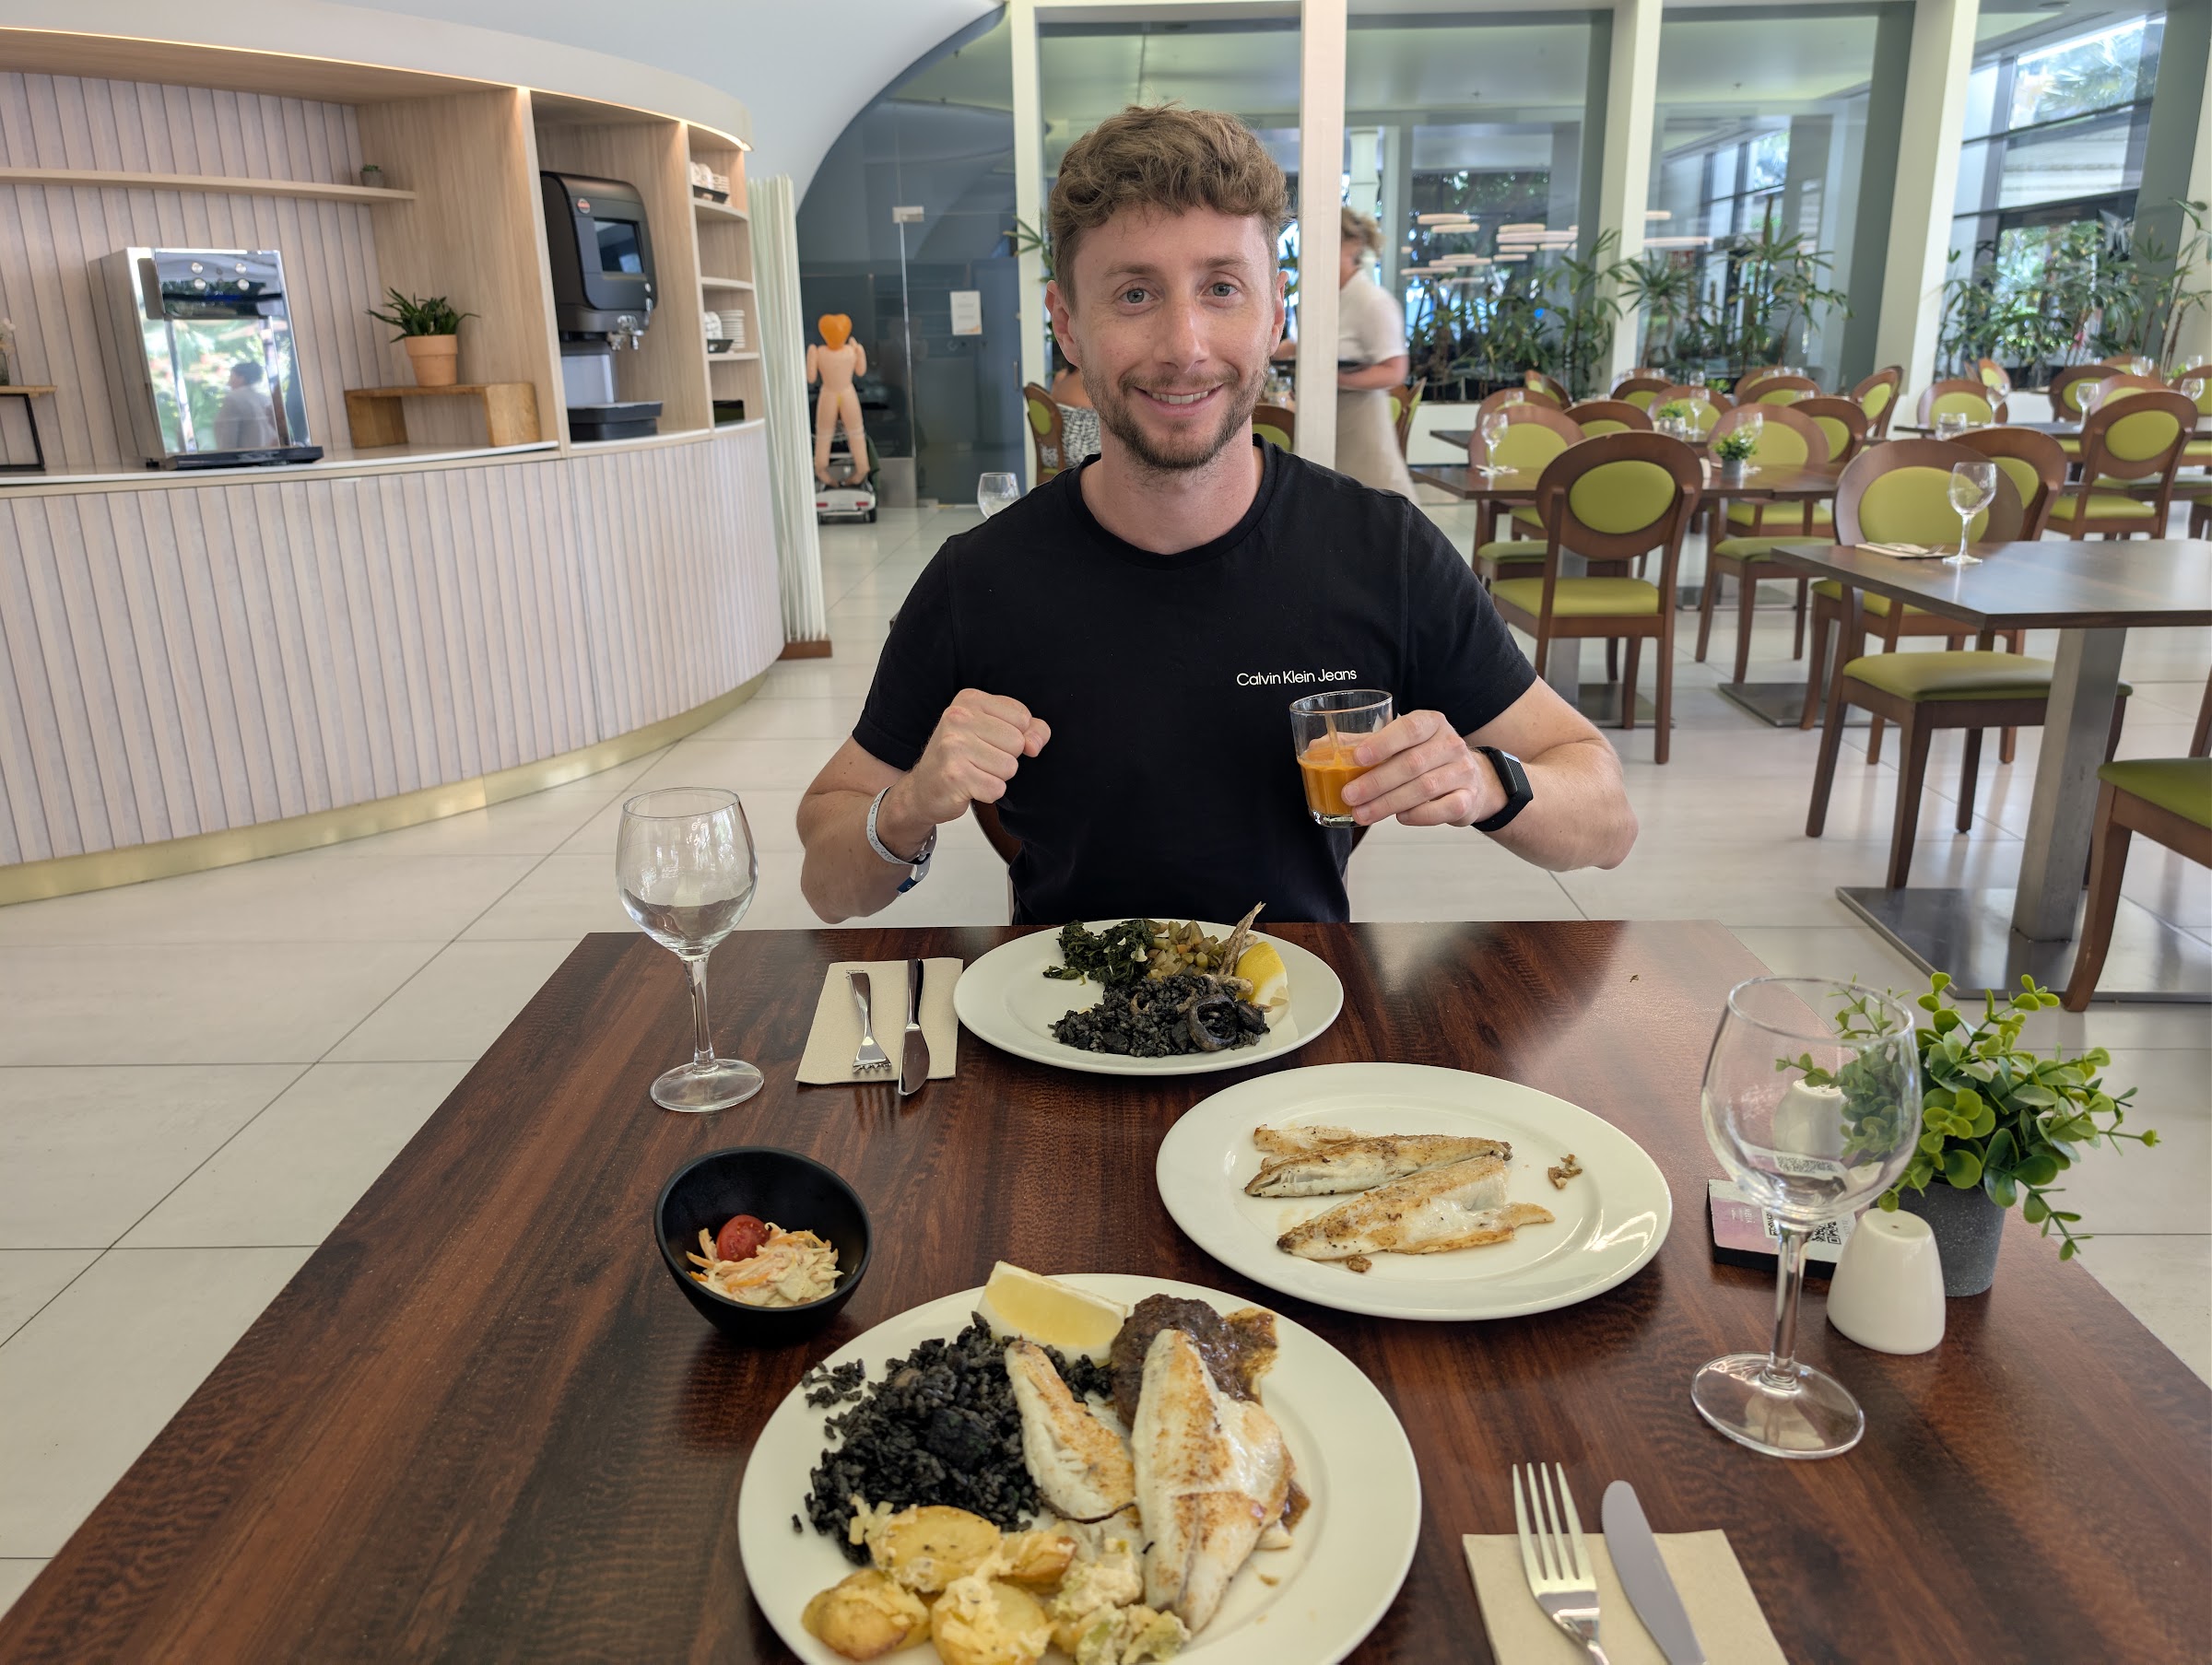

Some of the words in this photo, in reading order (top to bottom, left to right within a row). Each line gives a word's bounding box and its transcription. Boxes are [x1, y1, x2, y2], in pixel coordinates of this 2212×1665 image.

[1236, 671, 1281, 686] Calvin
[1282, 670, 1316, 684] Klein
[1318, 668, 1358, 682] Jeans
